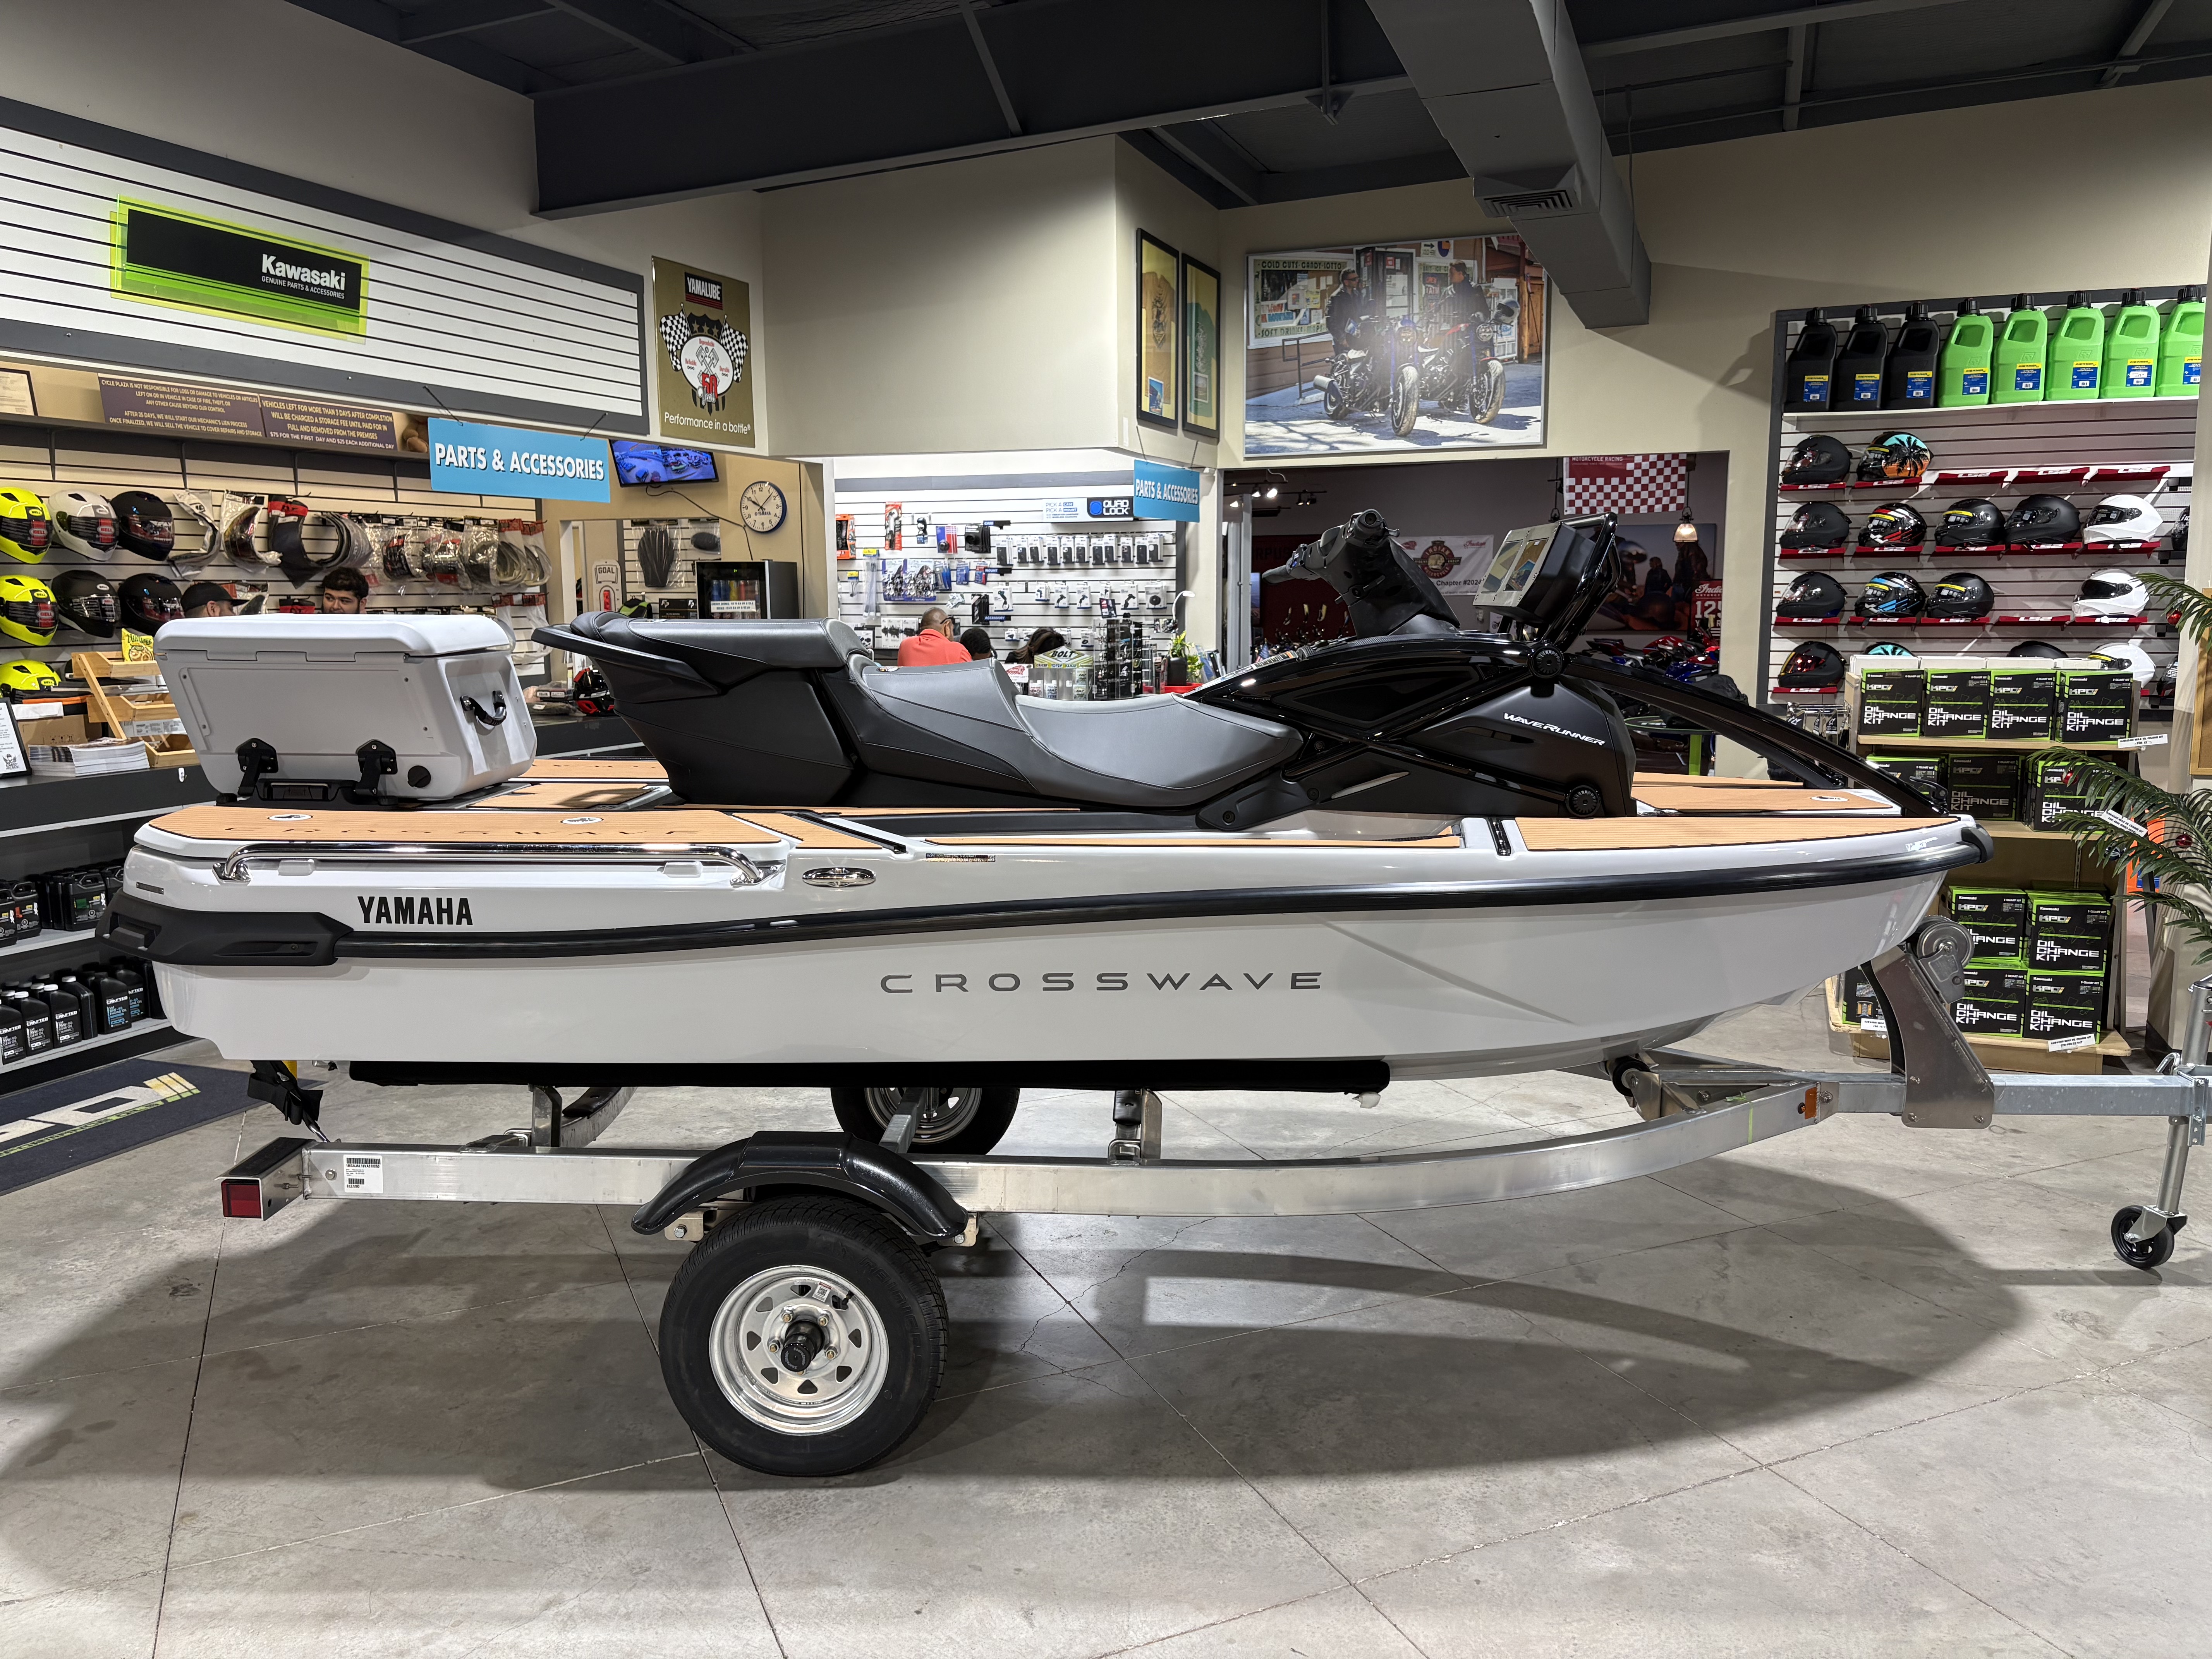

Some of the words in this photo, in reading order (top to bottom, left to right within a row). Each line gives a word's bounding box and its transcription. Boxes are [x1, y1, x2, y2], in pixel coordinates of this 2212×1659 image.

[262, 254, 345, 290] Kawasaki
[262, 276, 286, 286] GENUINE
[287, 281, 304, 290] PARTS
[310, 287, 344, 299] ACCESSORIES
[687, 277, 721, 301] YAMALUBE
[262, 400, 285, 409] VEHICLES
[366, 413, 393, 422] COMPLETION
[665, 412, 713, 429] Performance
[715, 420, 720, 430] in
[723, 422, 727, 431] a
[435, 443, 487, 470] PARTS
[493, 449, 505, 472] &
[510, 451, 604, 481] ACCESSORIES
[1136, 479, 1155, 499] PARTS
[1157, 483, 1162, 500] &
[1163, 484, 1198, 505] ACCESSORIES
[1425, 546, 1450, 555] INDIAN
[1695, 584, 1723, 593] Indi
[1504, 713, 1605, 745] WAVERUNNER
[357, 896, 473, 925] YAMAHA
[2037, 947, 2099, 957] CHANGE
[880, 972, 1322, 994] CROSSWAVE
[1956, 1010, 2017, 1021] CHANGE
[2031, 1017, 2092, 1028] CHANGE
